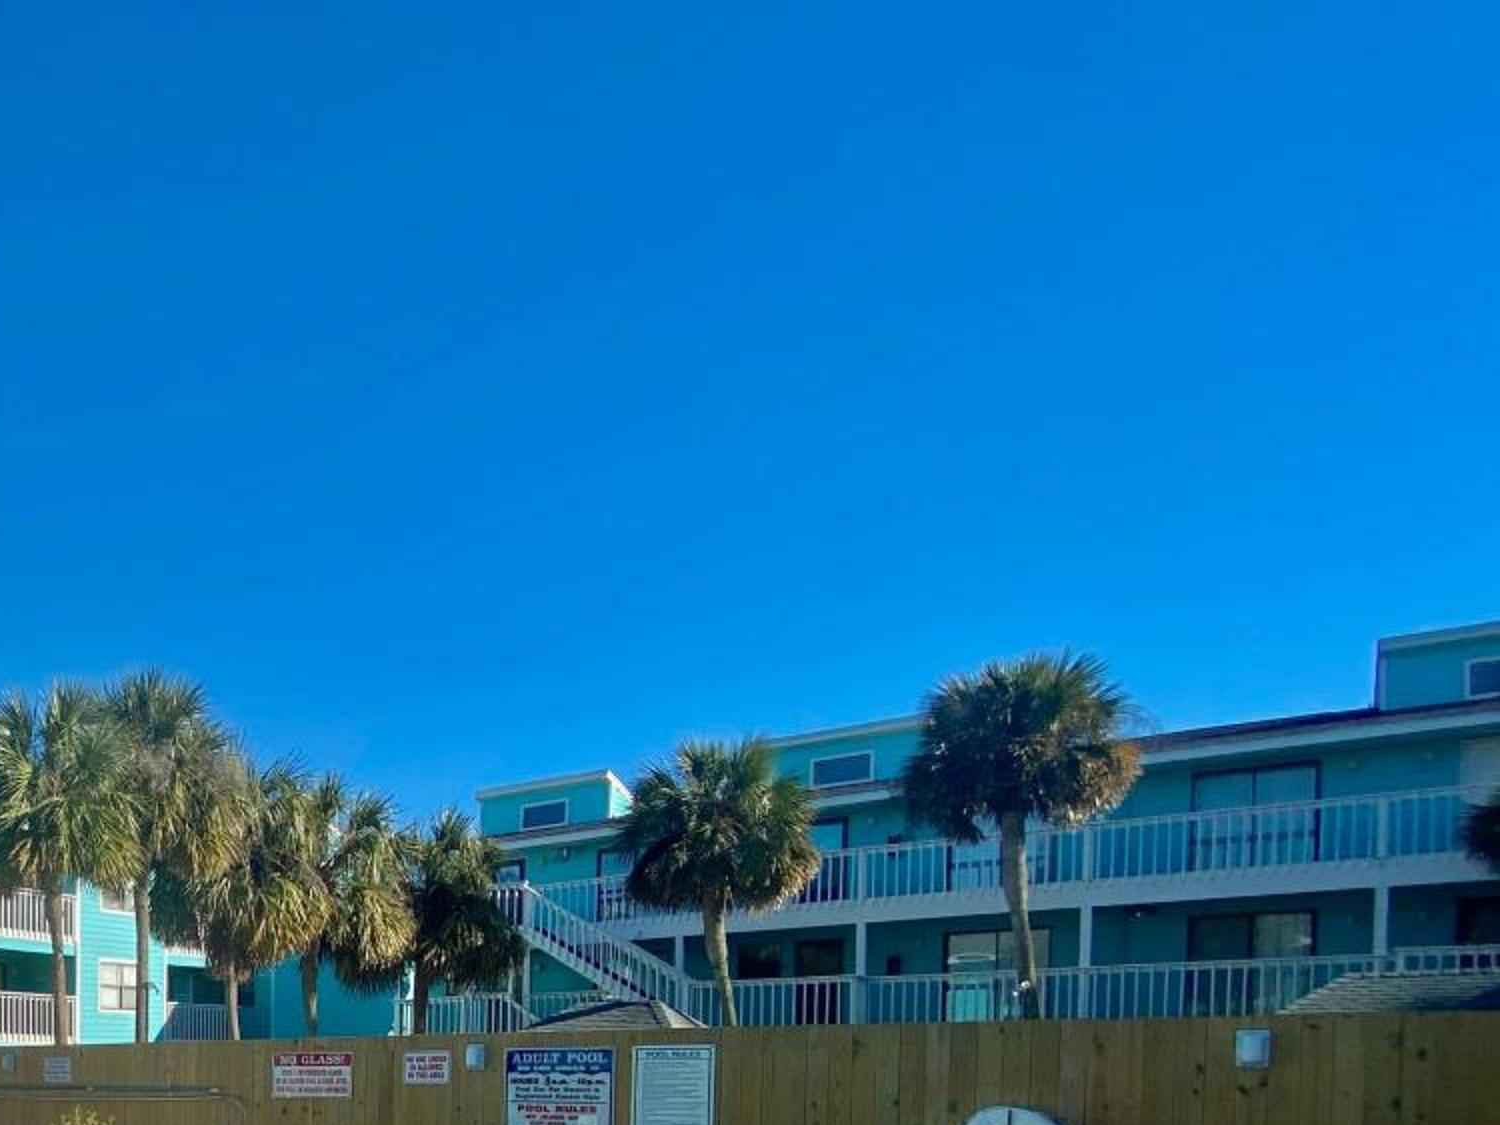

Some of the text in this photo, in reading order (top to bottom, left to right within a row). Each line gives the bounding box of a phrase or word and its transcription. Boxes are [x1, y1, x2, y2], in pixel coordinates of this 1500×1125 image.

[279, 1055, 297, 1065] NO
[512, 1052, 608, 1064] ADULT POOL
[517, 1104, 597, 1114] POOL RULES
